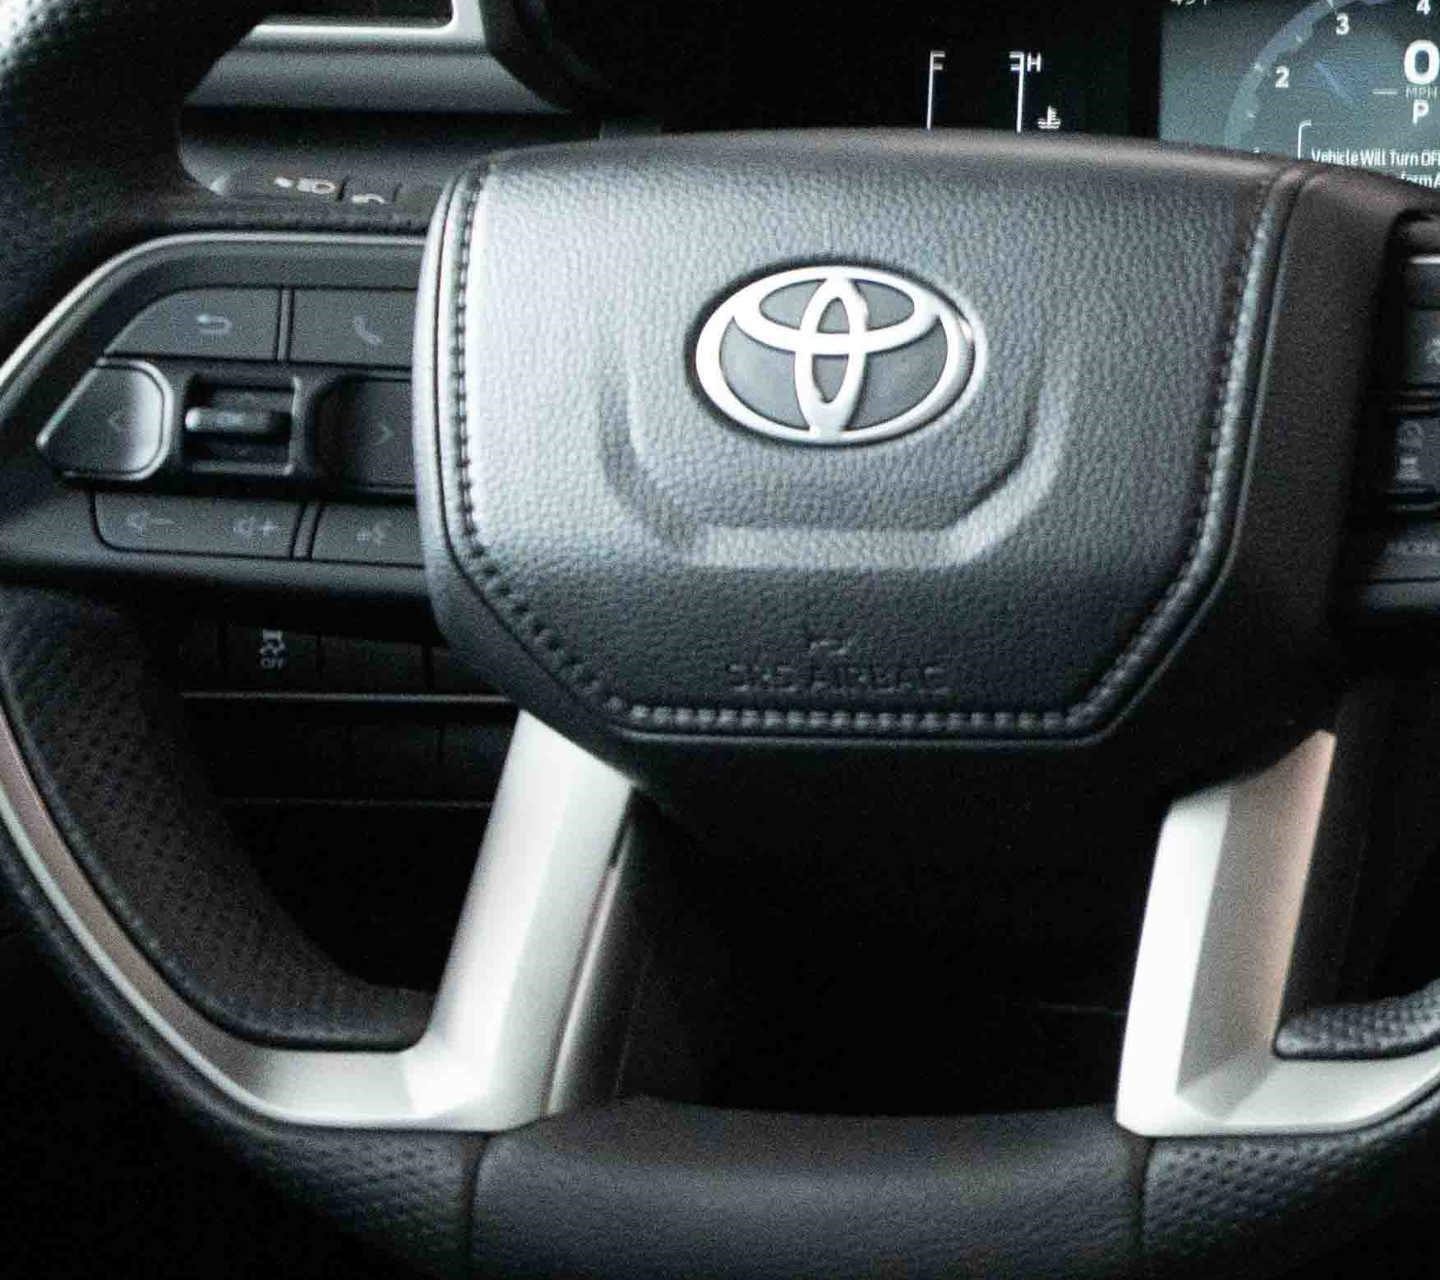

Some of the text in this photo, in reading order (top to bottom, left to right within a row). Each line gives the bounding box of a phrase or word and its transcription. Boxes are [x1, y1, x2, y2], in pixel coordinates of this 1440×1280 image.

[1335, 12, 1350, 36] 3
[1404, 40, 1440, 85] 0
[1275, 65, 1290, 89] 2
[1405, 87, 1438, 98] MPH
[1412, 99, 1429, 125] P
[1311, 147, 1359, 165] Vehicle
[1360, 148, 1387, 166] Will
[1389, 148, 1419, 167] Turn
